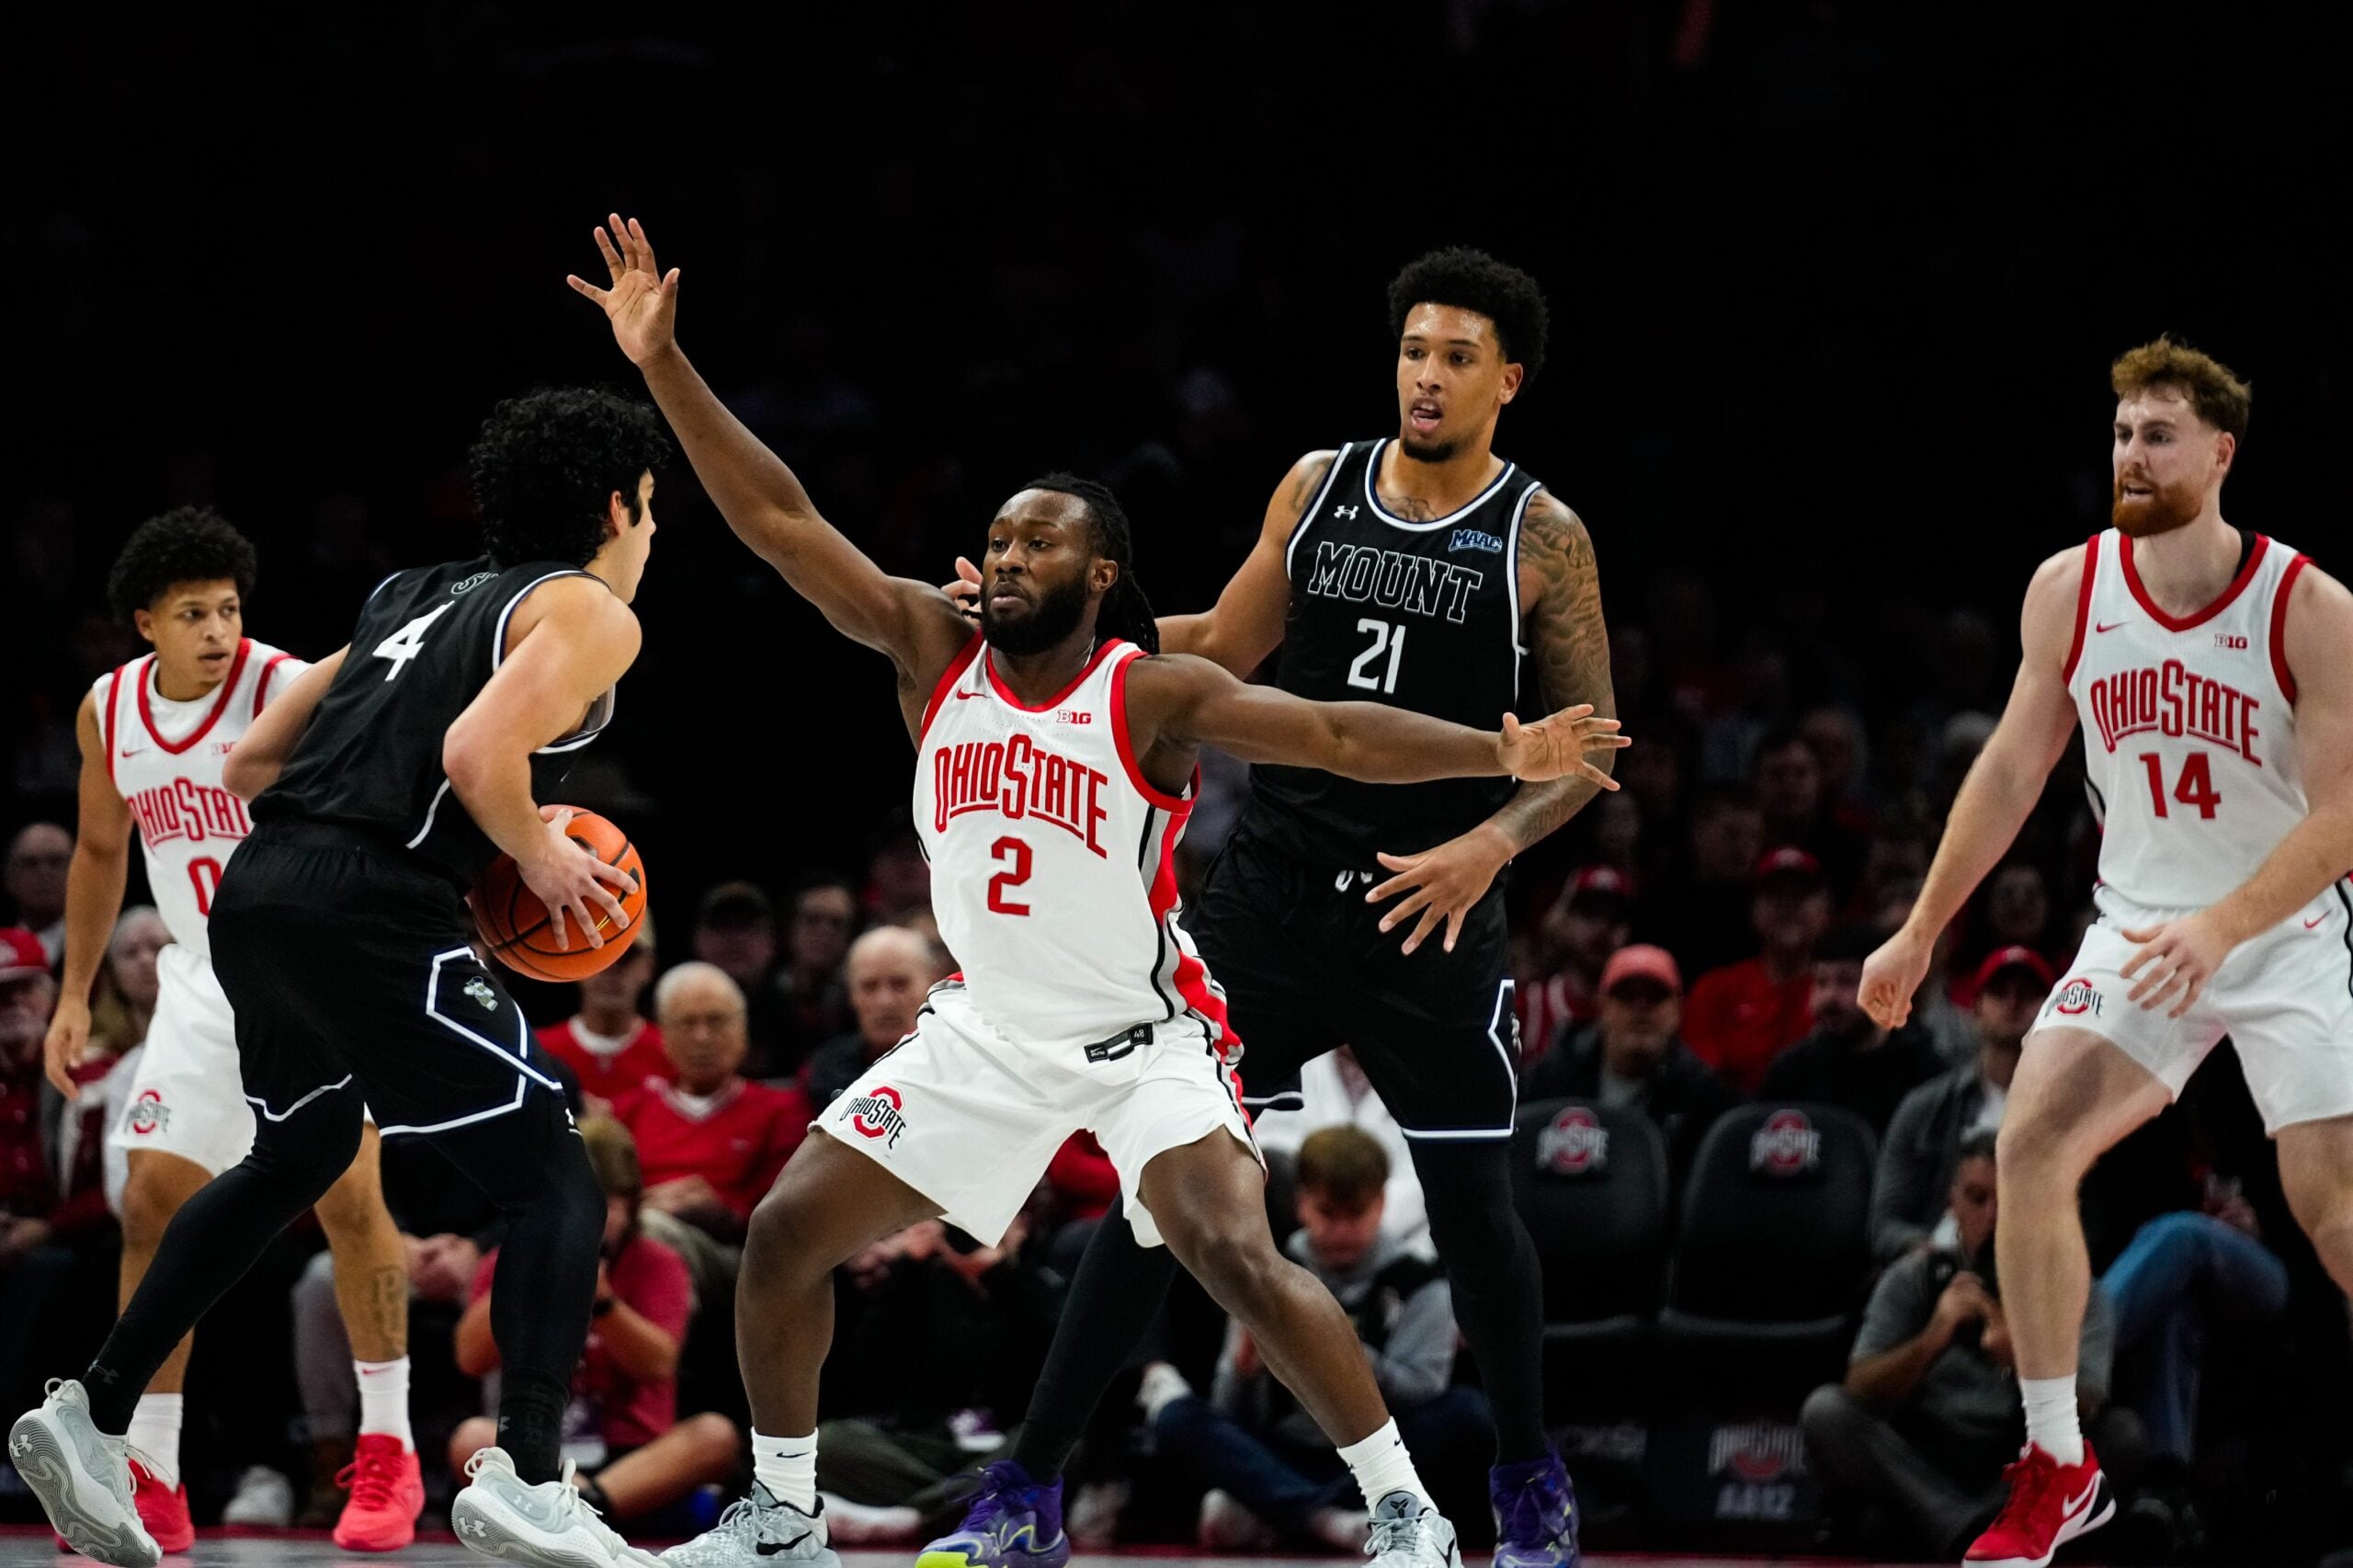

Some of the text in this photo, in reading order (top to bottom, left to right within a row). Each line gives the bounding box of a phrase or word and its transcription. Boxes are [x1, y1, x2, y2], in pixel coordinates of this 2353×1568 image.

[1449, 529, 1503, 552] MAAC
[1307, 540, 1483, 625] MOUNT
[371, 599, 455, 681] 4
[1347, 618, 1406, 695] 21
[2139, 751, 2222, 819] 14
[987, 835, 1032, 916] 2
[1133, 1028, 1145, 1039] 48
